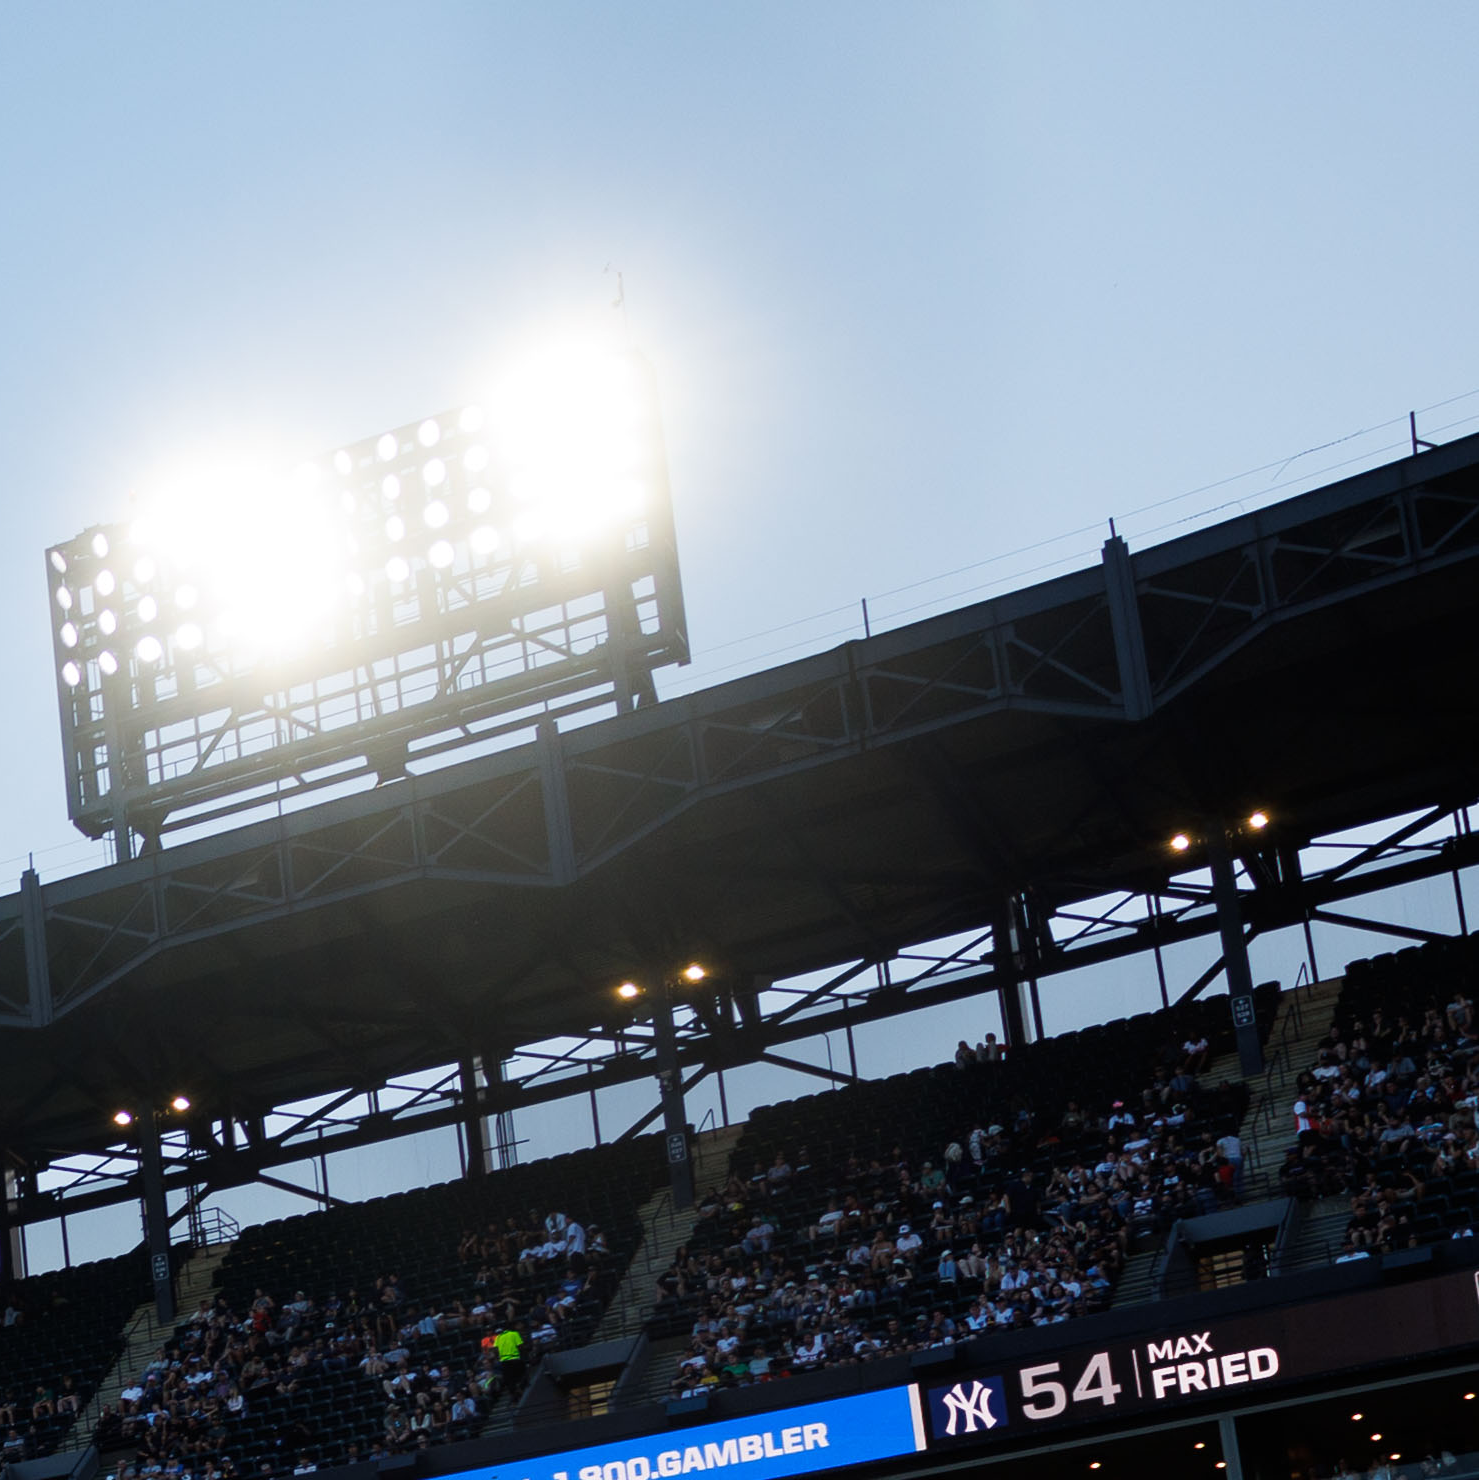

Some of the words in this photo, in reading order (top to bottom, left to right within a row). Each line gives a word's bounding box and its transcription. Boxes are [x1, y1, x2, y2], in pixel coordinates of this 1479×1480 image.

[1148, 1332, 1212, 1364] MAX
[1152, 1347, 1280, 1400] FRIED
[1019, 1352, 1122, 1421] 54
